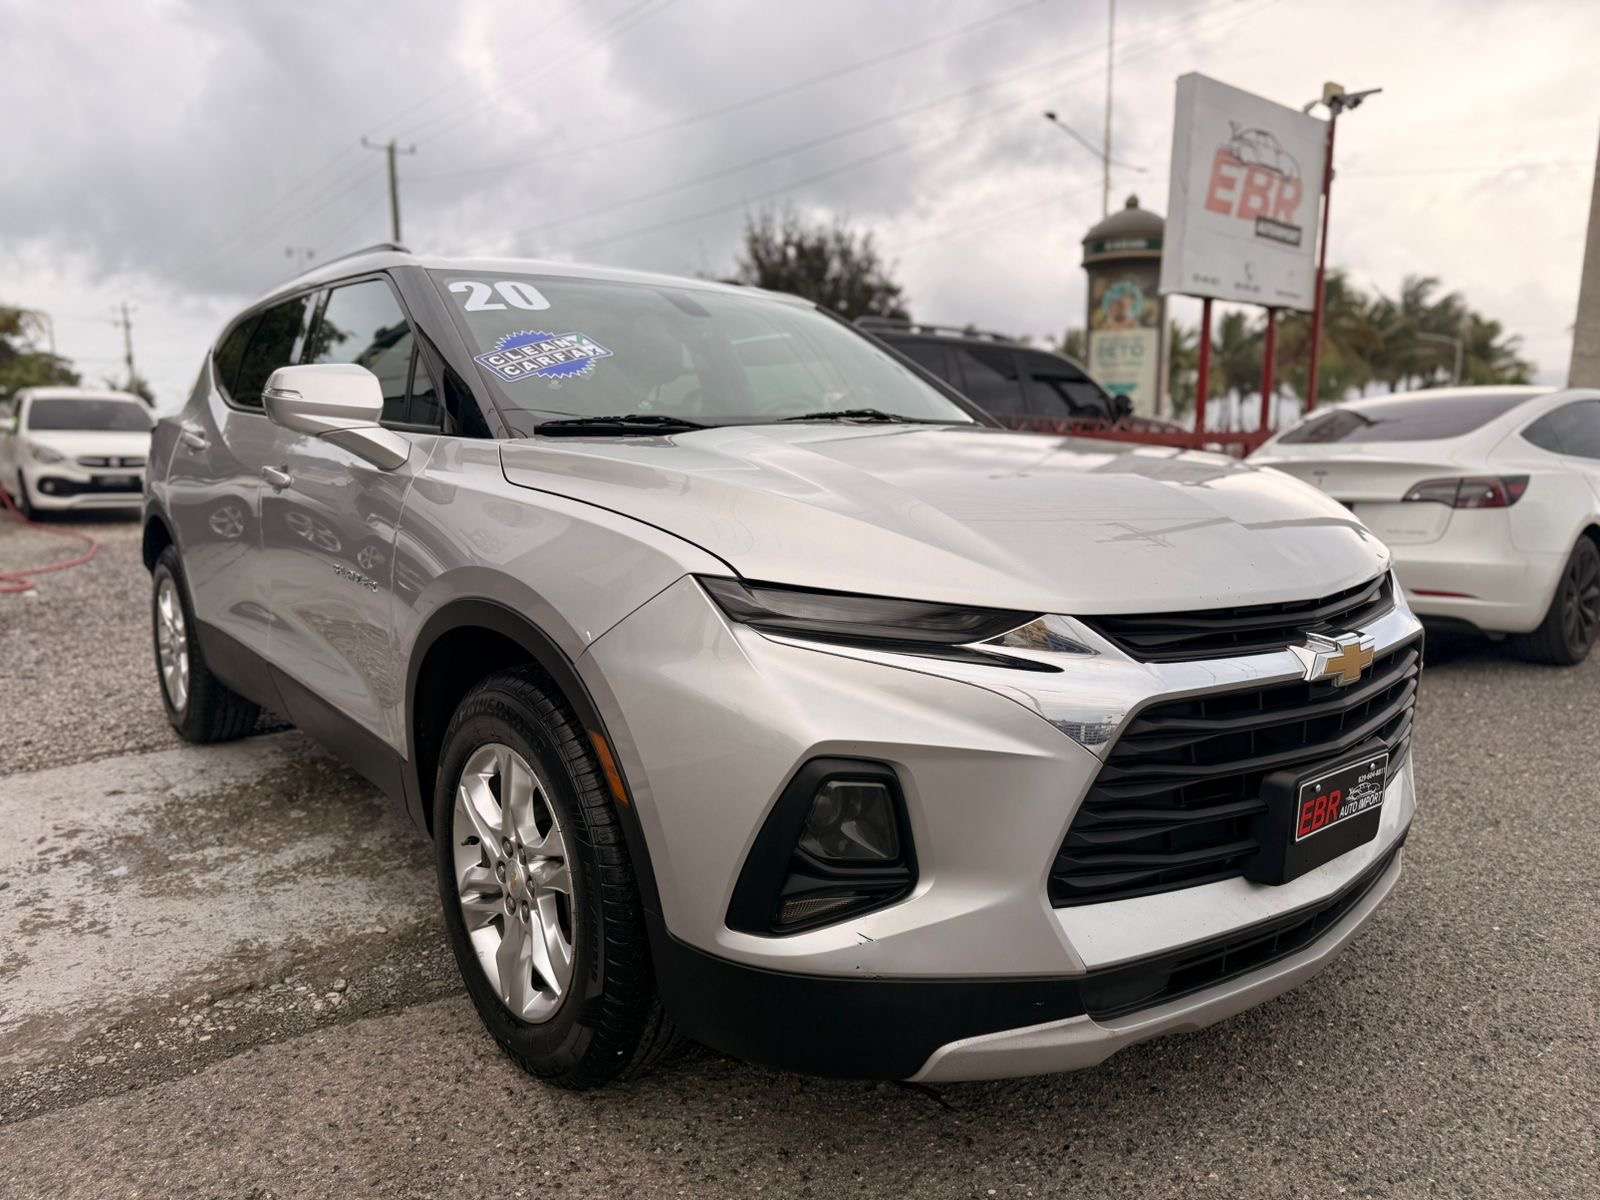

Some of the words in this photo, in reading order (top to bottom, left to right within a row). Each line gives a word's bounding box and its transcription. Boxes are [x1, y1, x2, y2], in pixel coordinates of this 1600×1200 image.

[1204, 147, 1303, 224] EBR
[448, 281, 551, 312] 20
[488, 338, 572, 365] CLEAN
[503, 346, 606, 375] CARFAX
[1298, 790, 1342, 836] EBR
[1339, 801, 1358, 818] AUTO
